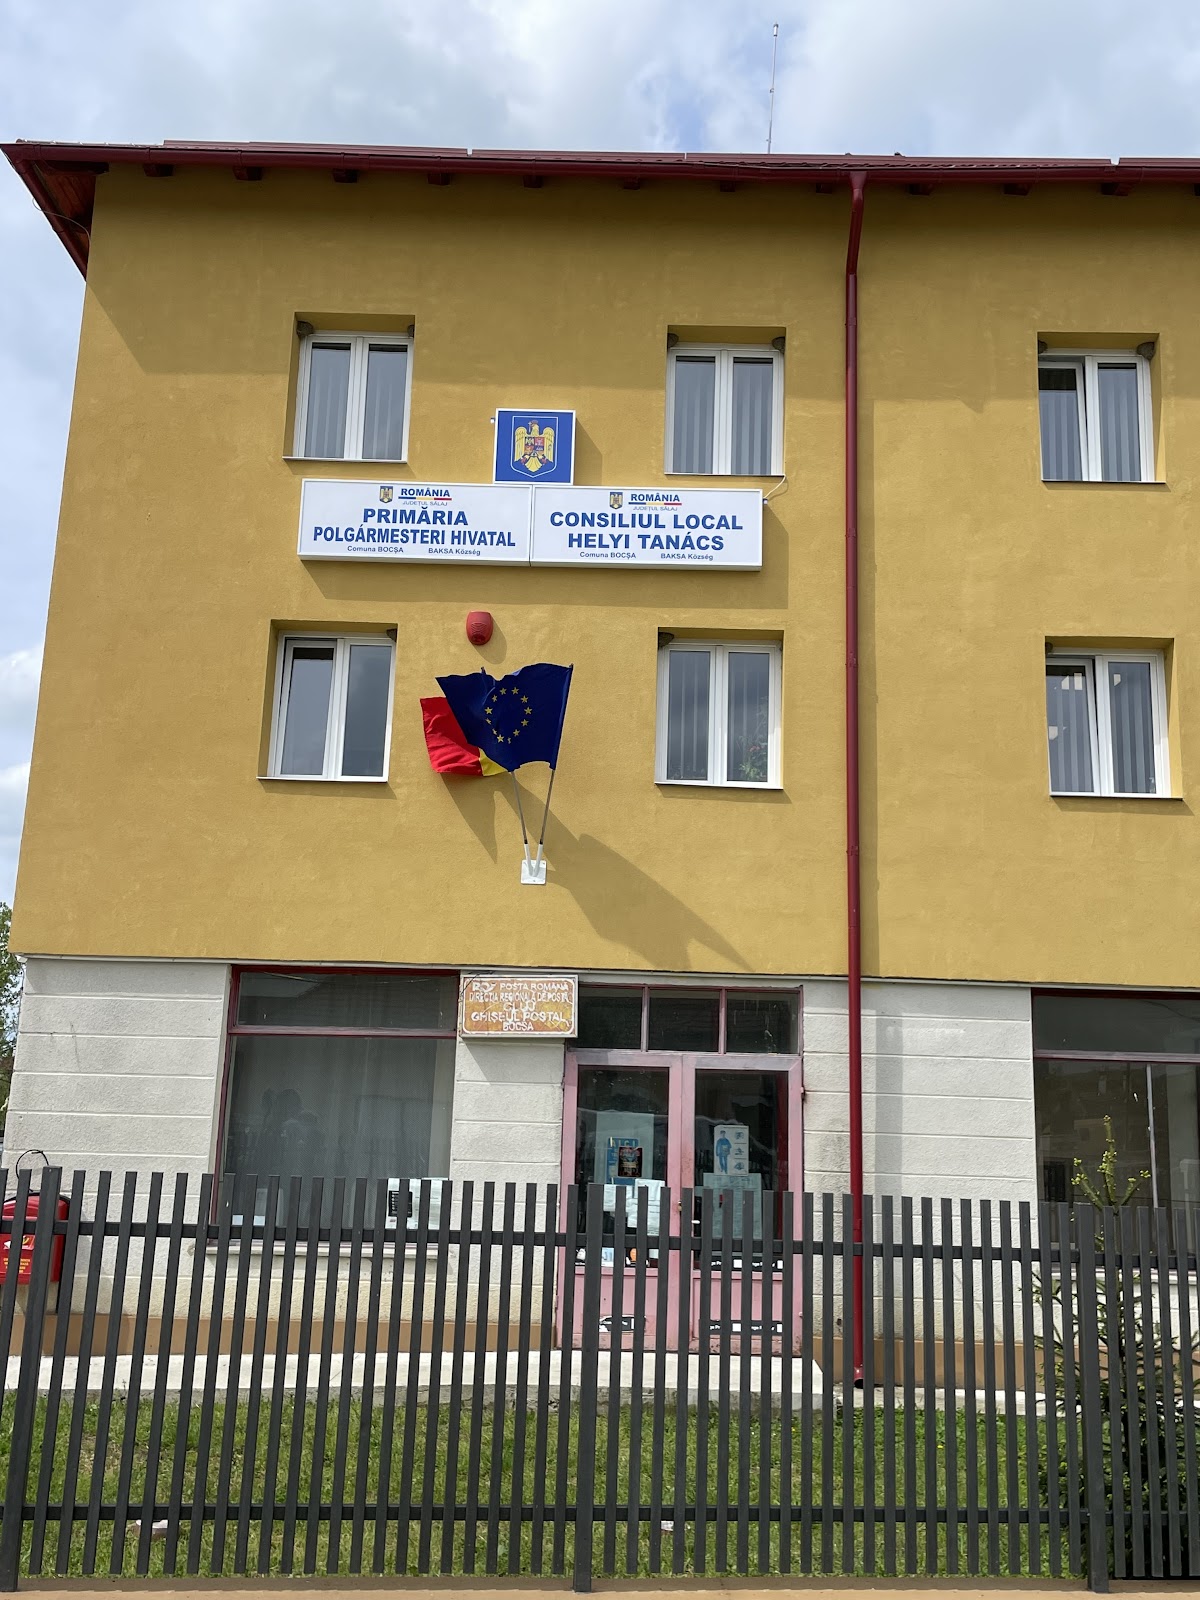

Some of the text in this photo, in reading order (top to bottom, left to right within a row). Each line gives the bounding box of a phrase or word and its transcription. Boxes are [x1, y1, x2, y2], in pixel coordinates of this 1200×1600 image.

[401, 487, 450, 497] ROMÂNIA
[630, 492, 680, 502] ROMÂNIA
[363, 506, 469, 526] PRIMĂRIA
[550, 511, 743, 530] CONSILIUL LOCAL
[313, 524, 516, 547] POLGÁRMESTERI HIVATAL
[568, 532, 724, 551] HELYI TANÁCS
